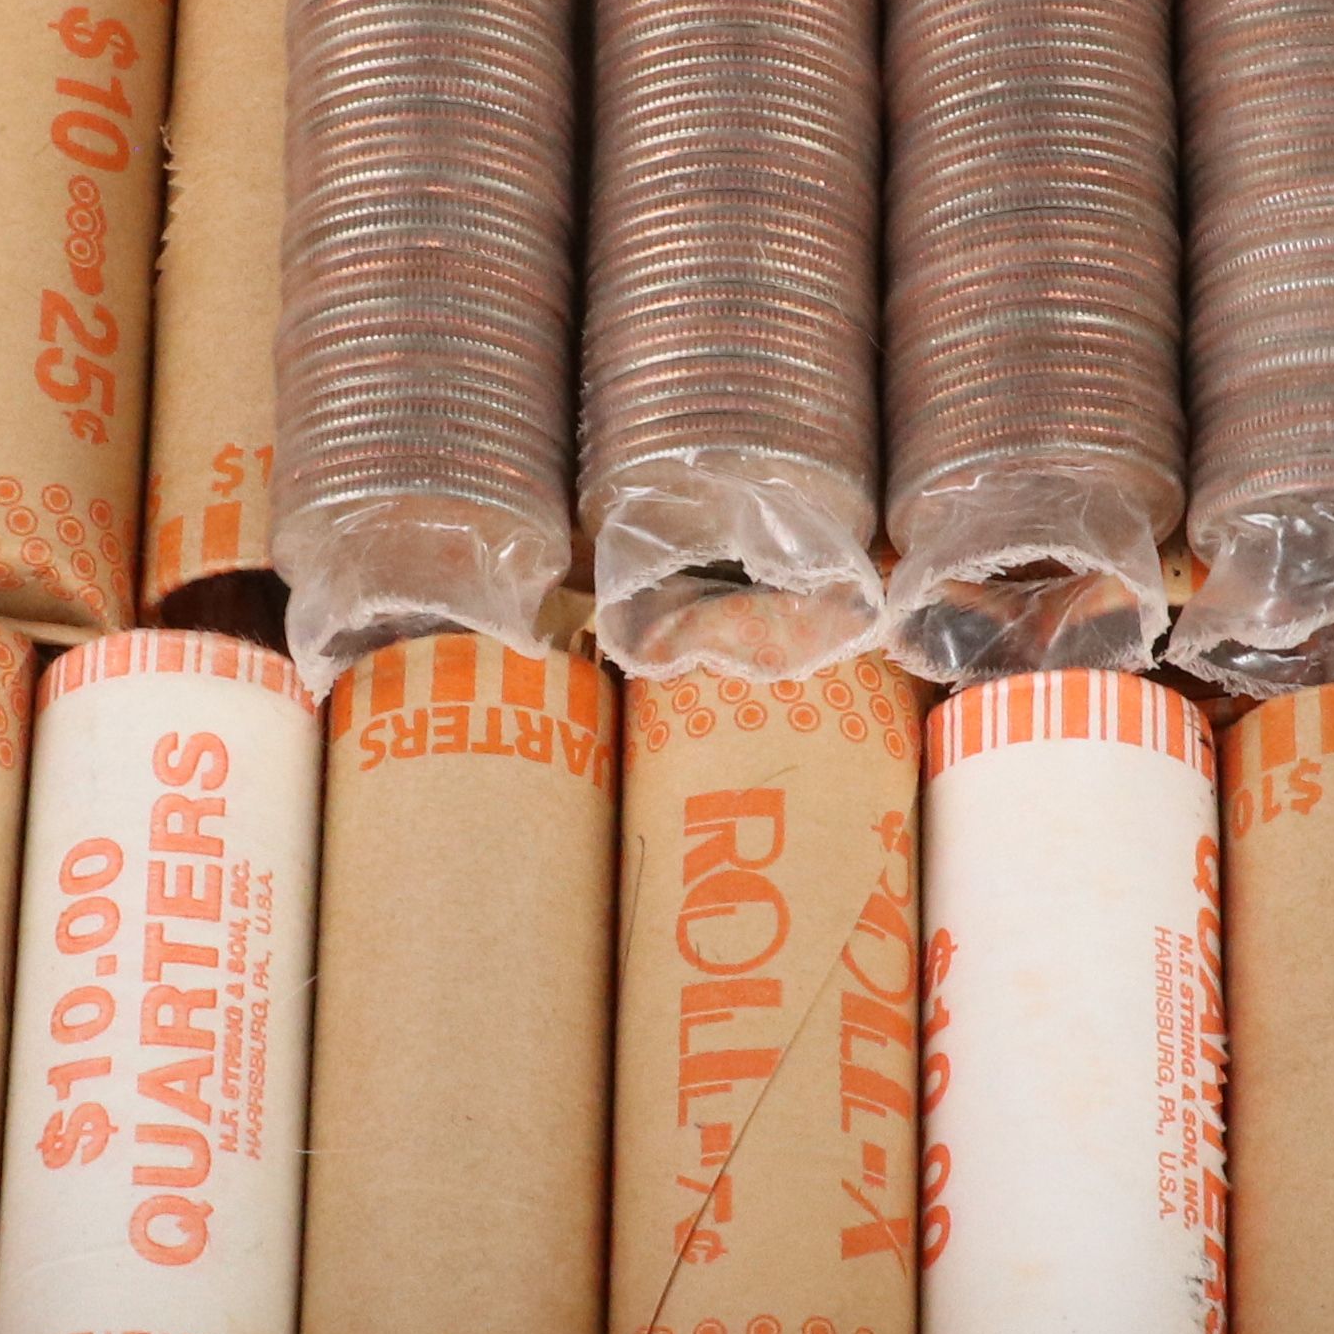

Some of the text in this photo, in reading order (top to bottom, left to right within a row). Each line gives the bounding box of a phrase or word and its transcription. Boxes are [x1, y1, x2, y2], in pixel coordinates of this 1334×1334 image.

[33, 6, 139, 446] $10 25¢
[210, 442, 275, 499] $1
[1230, 757, 1325, 840] $10
[35, 836, 125, 1170] $10.00
[127, 730, 230, 1268] QUARTERS
[1154, 924, 1178, 1088] HARRISBURG,
[1179, 981, 1197, 1078] STRING
[220, 1004, 246, 1101] STRING
[1181, 1106, 1200, 1169] SON,
[1182, 1176, 1201, 1231] INC.
